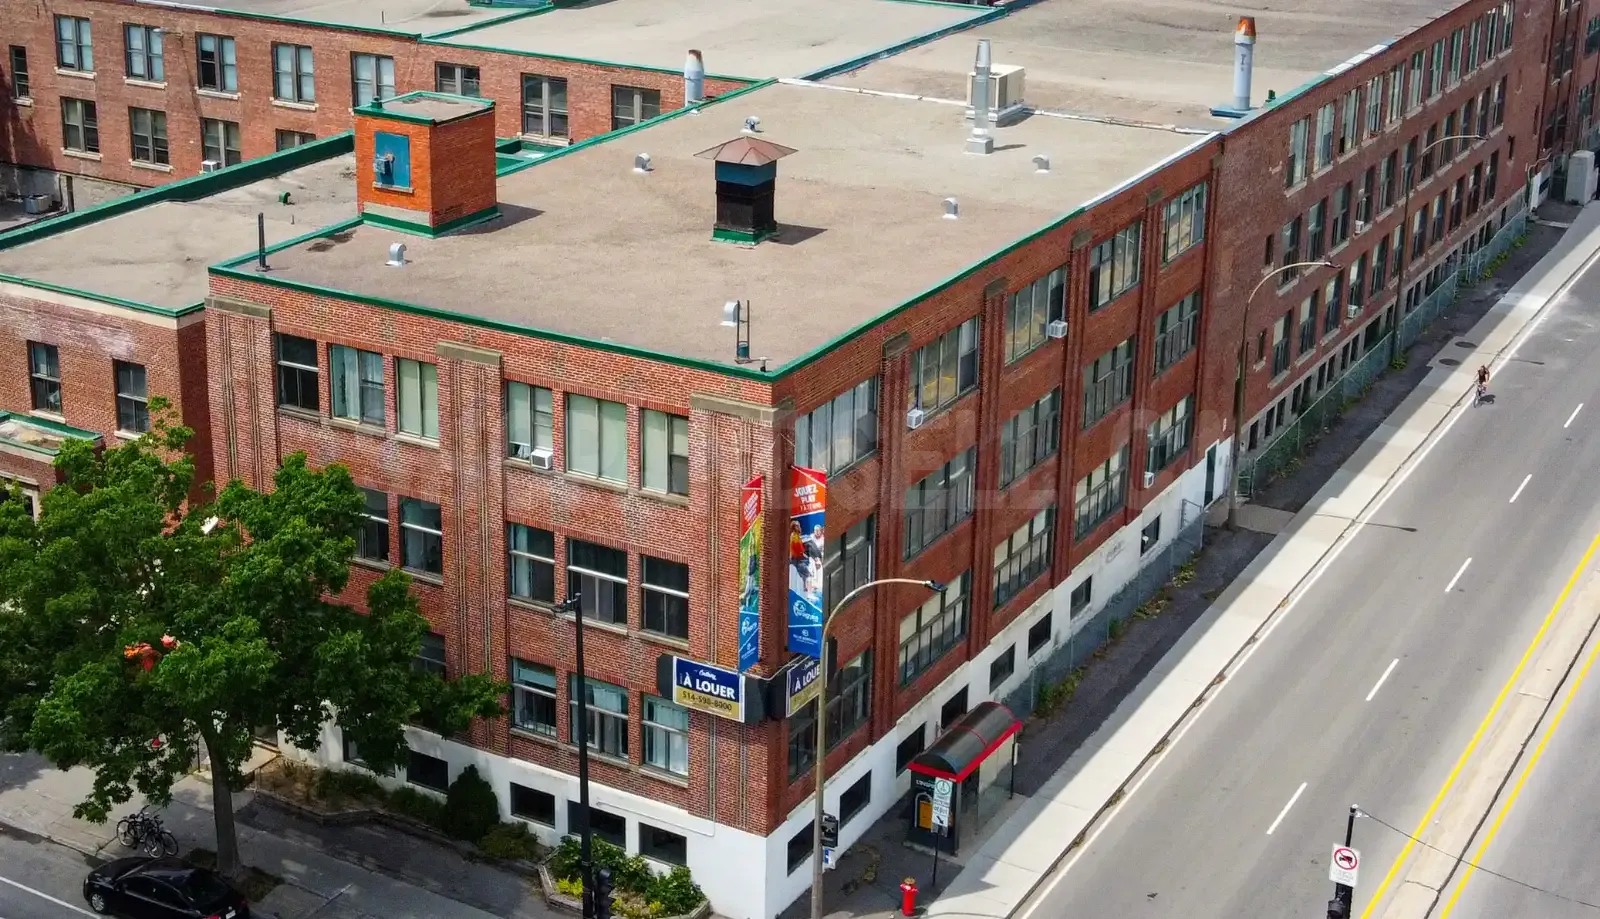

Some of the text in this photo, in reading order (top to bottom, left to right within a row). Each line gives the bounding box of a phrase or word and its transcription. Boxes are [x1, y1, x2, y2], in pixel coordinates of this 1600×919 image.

[683, 672, 692, 688] À
[695, 679, 736, 700] LOUER
[802, 664, 821, 687] LOUE
